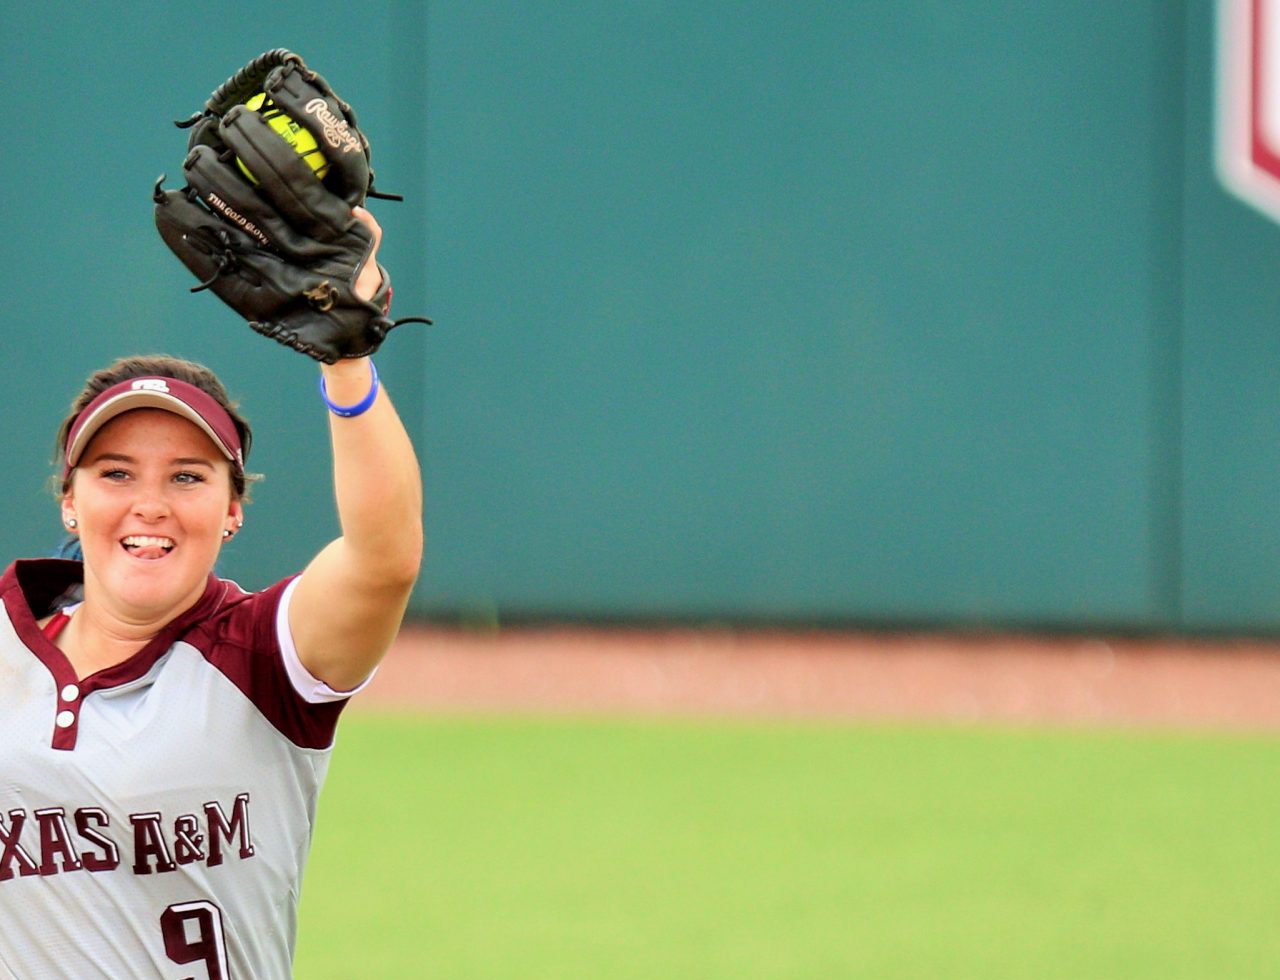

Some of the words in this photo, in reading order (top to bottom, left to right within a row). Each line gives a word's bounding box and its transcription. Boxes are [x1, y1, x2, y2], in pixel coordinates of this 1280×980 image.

[305, 98, 362, 152] Rawlings
[208, 192, 226, 210] THE
[224, 207, 247, 225] GOLD
[245, 222, 269, 244] GLOVE
[129, 793, 256, 875] A&M
